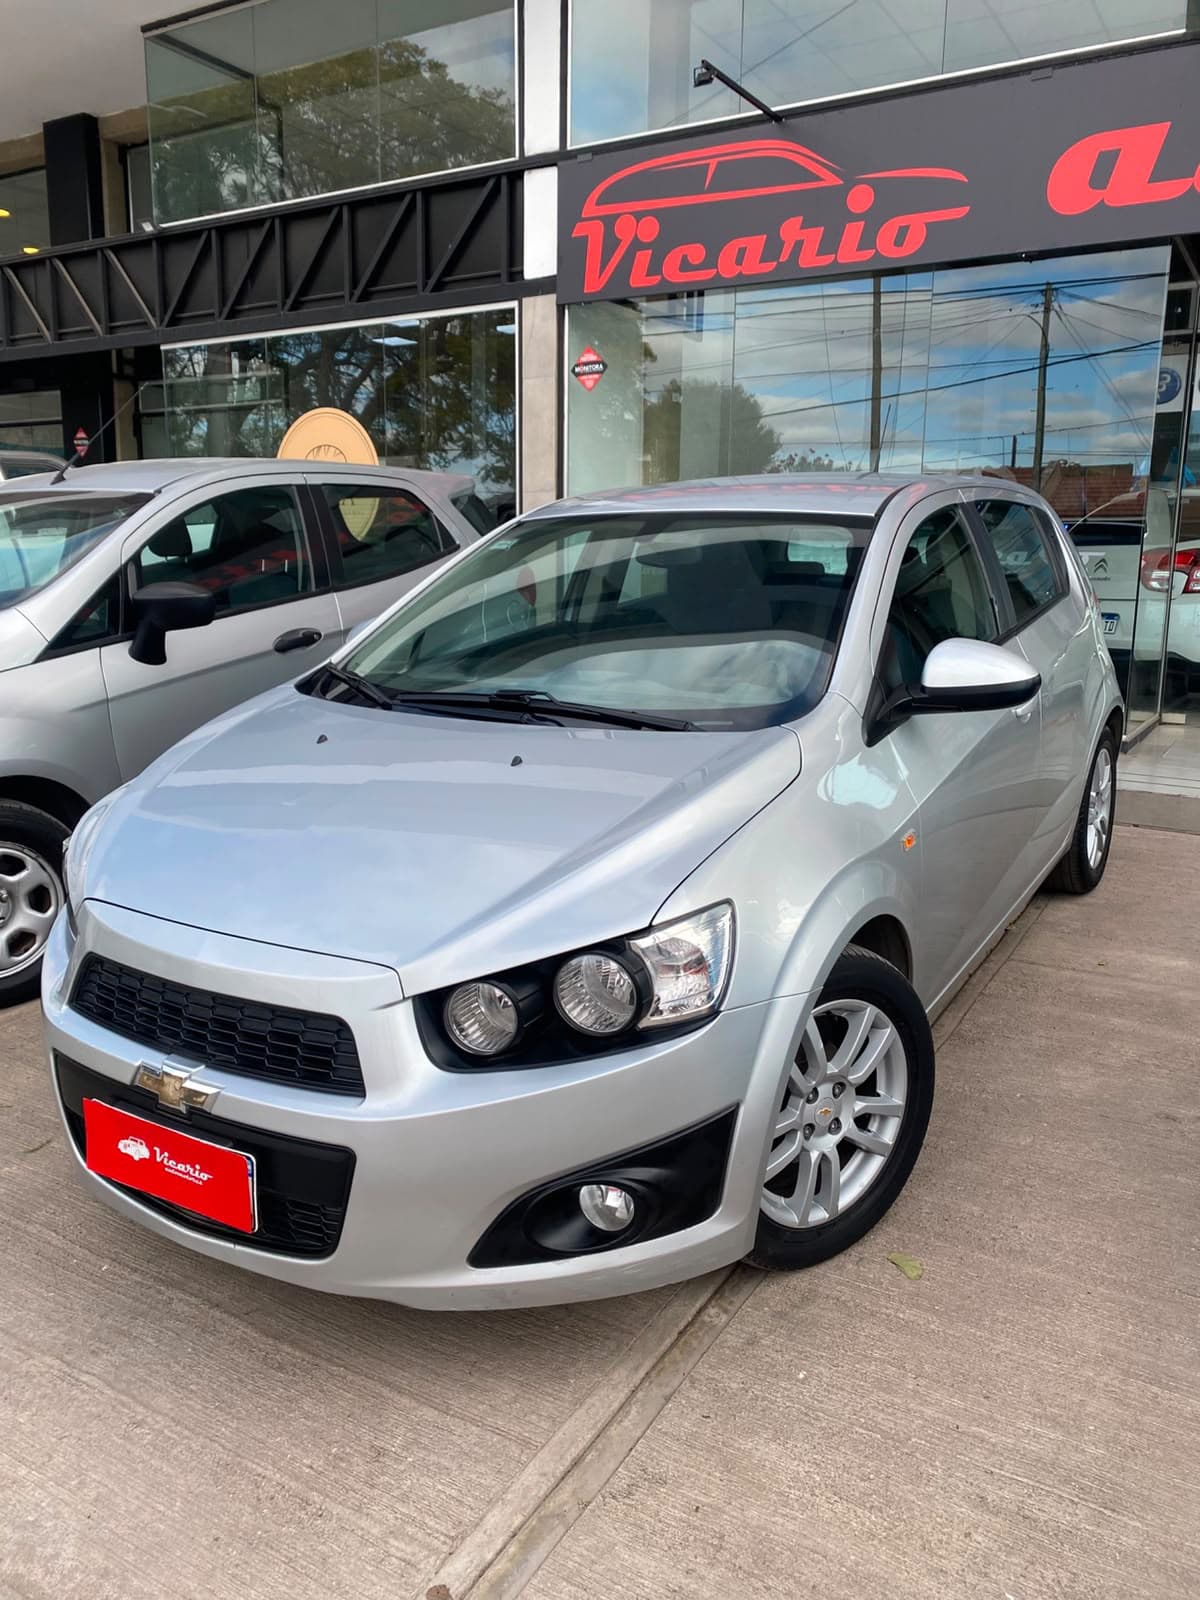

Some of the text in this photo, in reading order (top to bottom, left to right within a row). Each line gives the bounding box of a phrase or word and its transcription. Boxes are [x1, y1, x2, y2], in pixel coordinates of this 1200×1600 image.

[571, 121, 1200, 294] Vicario a
[153, 1146, 213, 1181] Vicario
